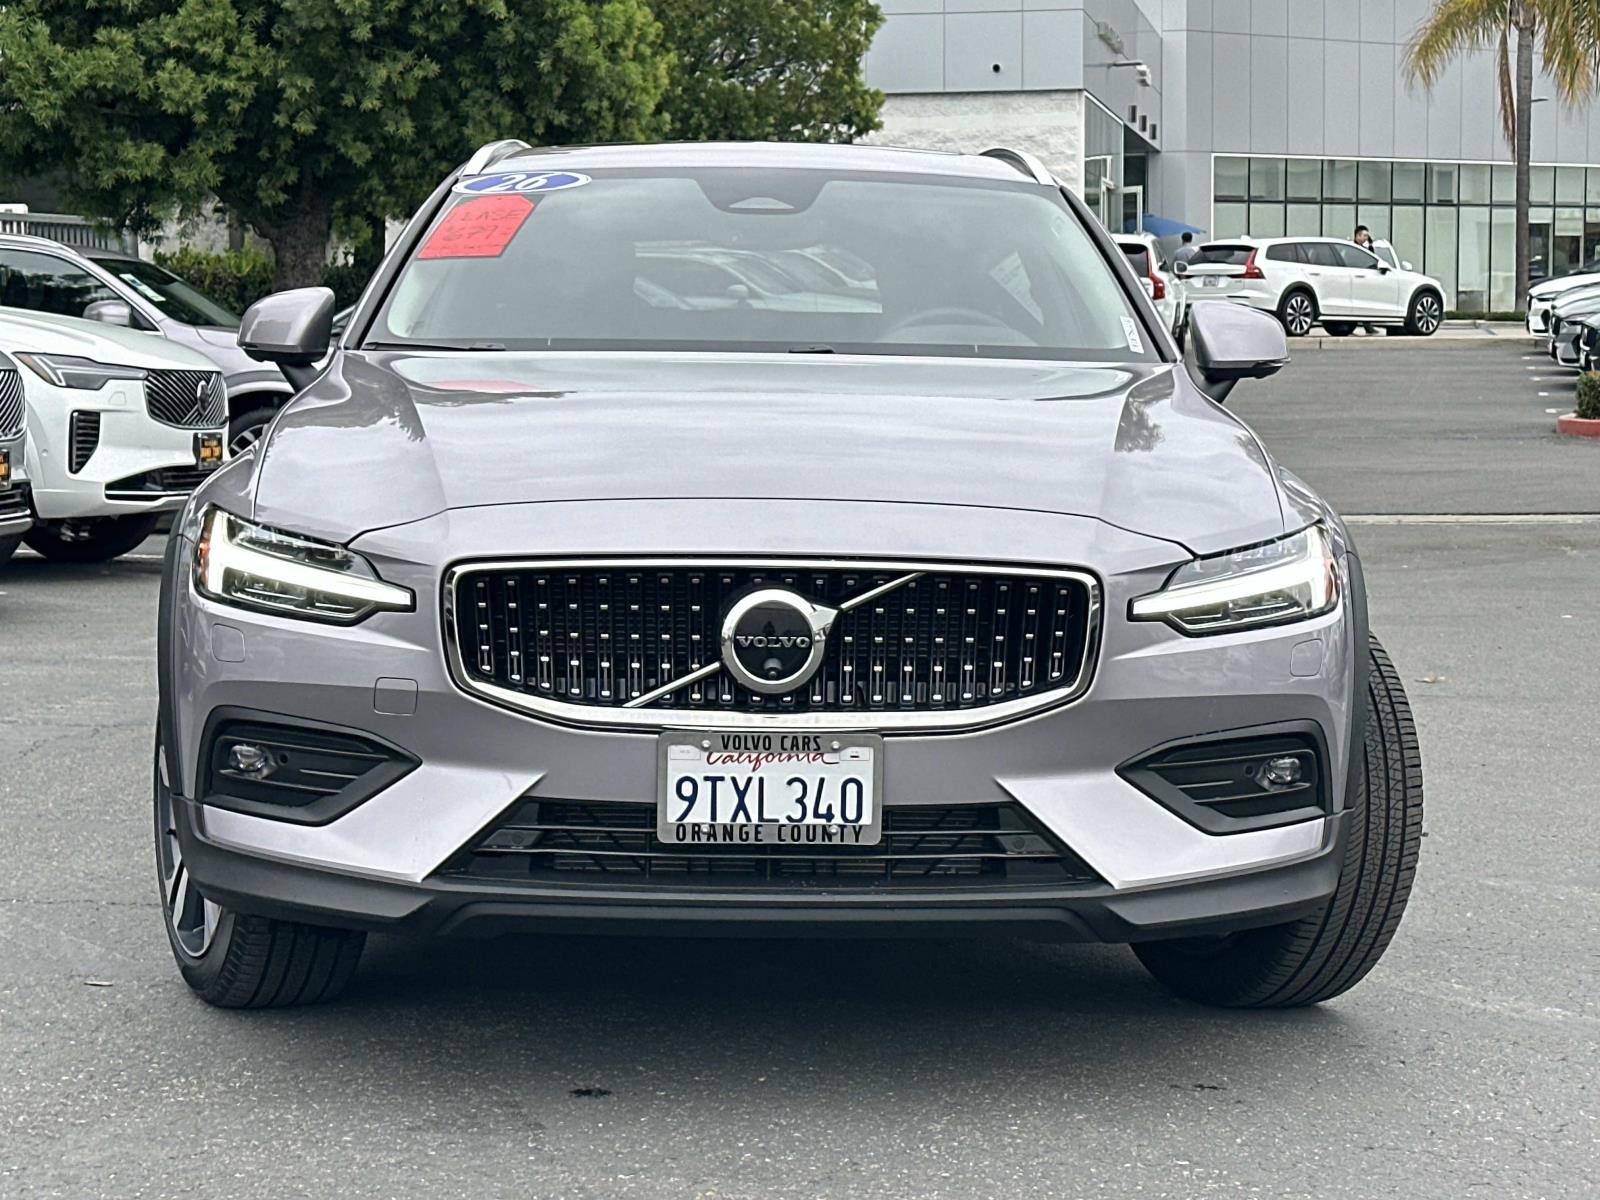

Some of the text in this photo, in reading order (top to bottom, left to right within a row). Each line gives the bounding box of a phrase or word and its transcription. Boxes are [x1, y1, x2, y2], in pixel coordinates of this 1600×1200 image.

[484, 172, 556, 191] 26
[736, 636, 810, 648] VOLVO
[721, 735, 821, 752] VOLVO CARS
[706, 751, 840, 772] California
[675, 775, 864, 824] 9TXL340
[675, 824, 863, 843] ORANGE COUNTY
